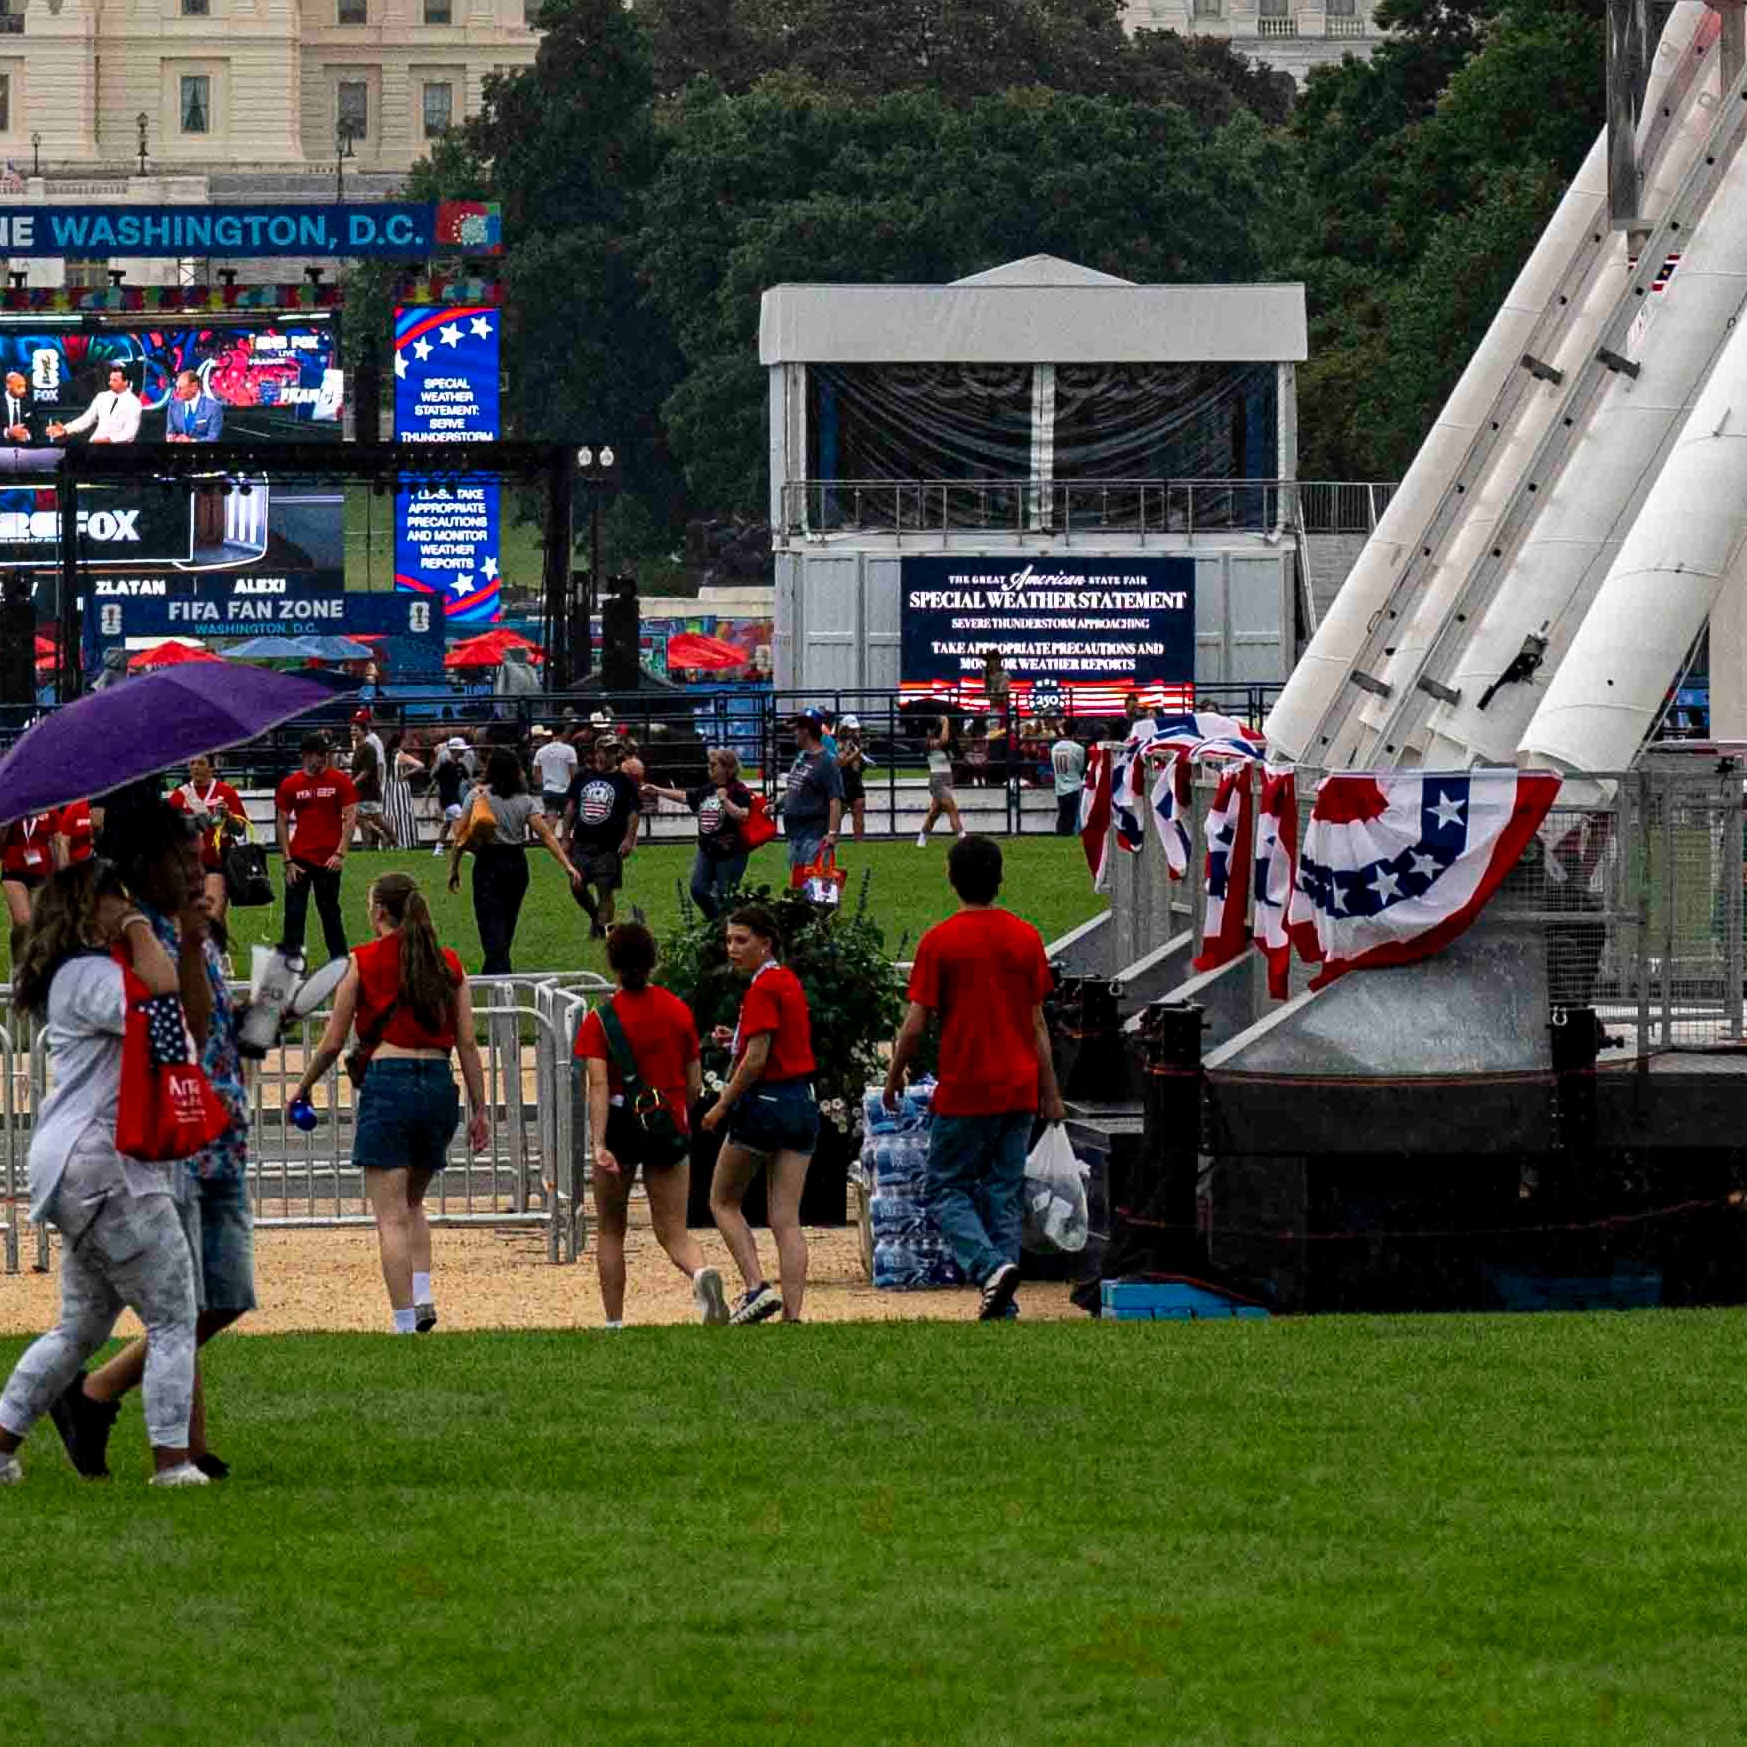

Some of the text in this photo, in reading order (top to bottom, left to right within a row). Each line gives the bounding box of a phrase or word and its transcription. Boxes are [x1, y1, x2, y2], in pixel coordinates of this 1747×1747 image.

[51, 214, 337, 250] WASHINGTON,
[349, 214, 424, 246] D.C.
[423, 378, 471, 390] SPECIAL
[33, 388, 59, 402] FOX
[420, 391, 474, 403] WEATHER
[401, 431, 494, 443] THUNDERSTORM
[456, 488, 485, 500] TAKE
[408, 502, 487, 514] APPROPRIATE
[407, 516, 488, 528] PRECAUTIONS
[407, 530, 488, 542] AND MONITOR
[420, 544, 475, 556] WEATHER
[420, 557, 475, 570] REPORTS
[948, 564, 1148, 592] THE GREAT American STATE FAIR
[95, 579, 166, 596] ZLATAN
[233, 578, 286, 594] ALEXI
[909, 591, 1188, 609] SPECIAL WEATHER STATEMENT
[167, 599, 344, 621] FIFA FAN ZONE
[951, 617, 1151, 629] SEVERE THUNDERSTORM APPROACHING
[931, 641, 966, 655] TAKE
[1052, 641, 1136, 655] PRECAUTIONS
[1137, 642, 1165, 655] AND
[1019, 658, 1080, 670] WEATHER
[1081, 658, 1136, 670] REPORTS
[1035, 695, 1059, 708] 250
